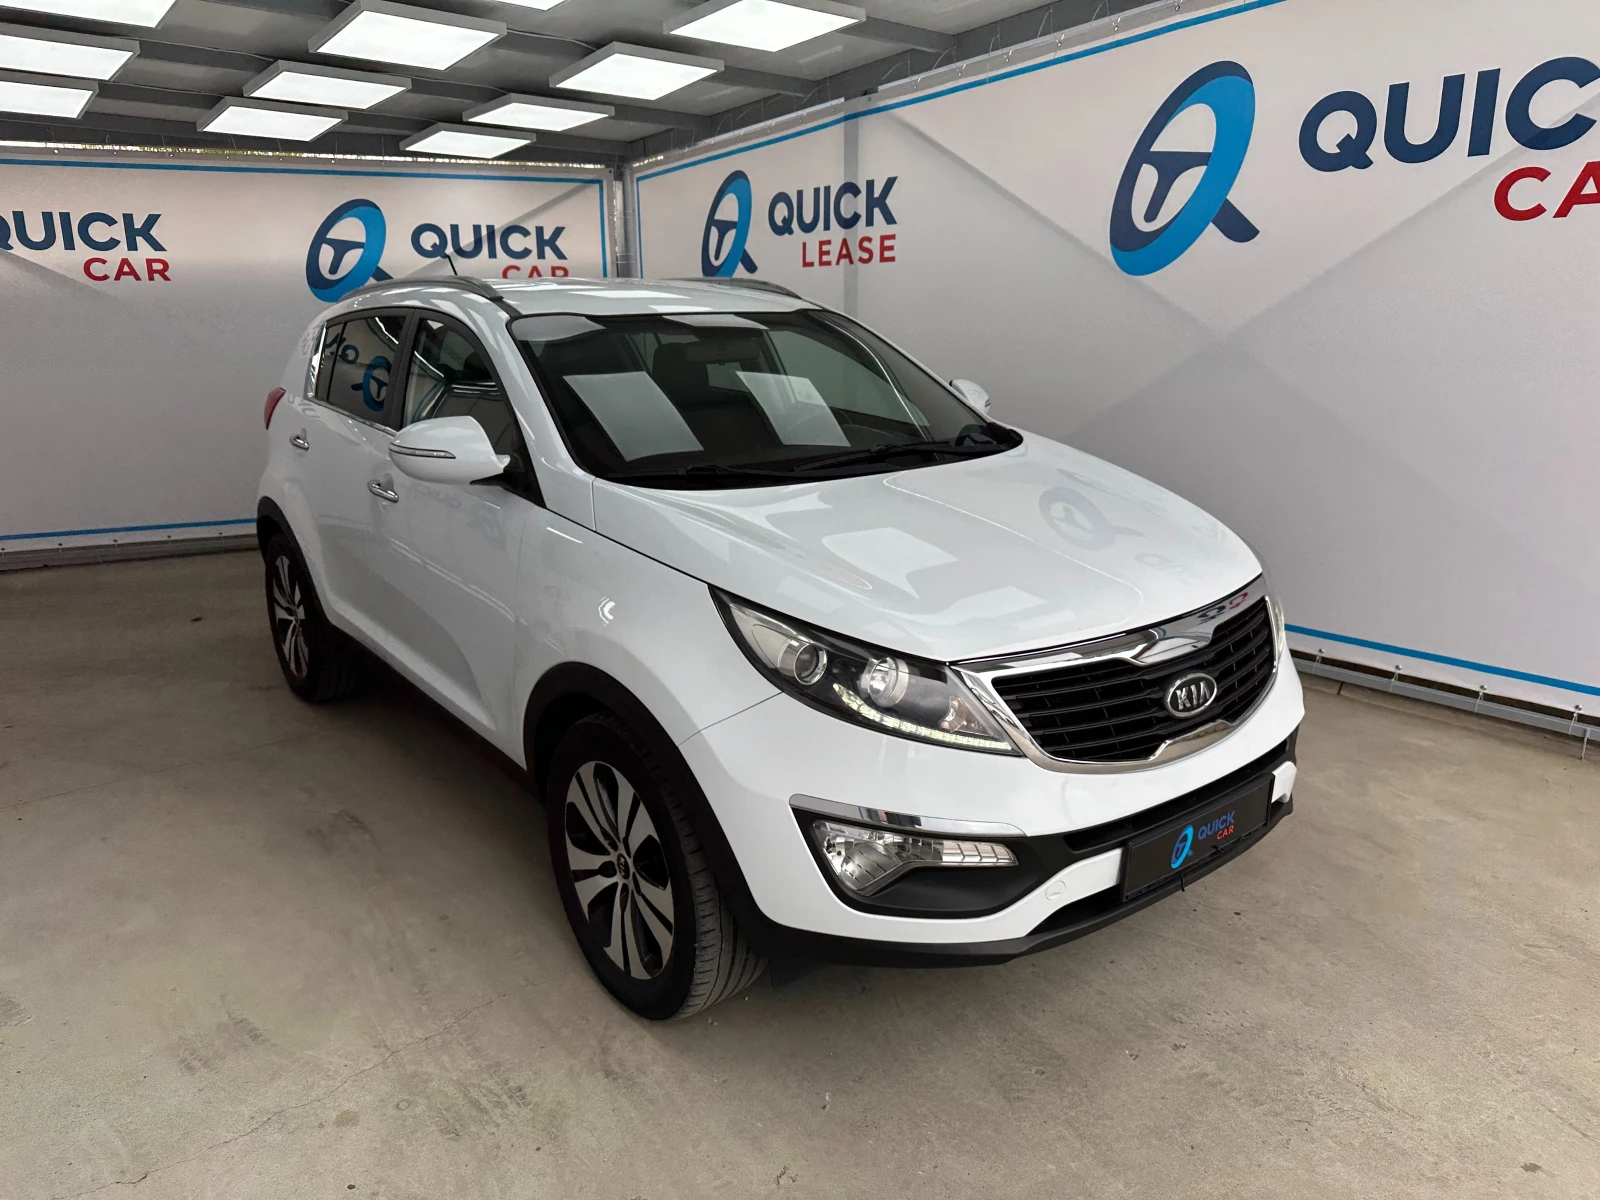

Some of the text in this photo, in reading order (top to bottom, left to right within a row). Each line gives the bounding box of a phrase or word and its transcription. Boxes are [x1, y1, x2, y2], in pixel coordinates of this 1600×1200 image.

[768, 176, 898, 236] QUICK
[0, 211, 167, 251] UICK
[411, 223, 568, 260] QUICK
[802, 234, 896, 267] LEASE
[83, 257, 171, 281] CAR
[1176, 681, 1210, 710] KIA
[1197, 810, 1235, 840] QUICK
[1216, 825, 1234, 840] CAR
